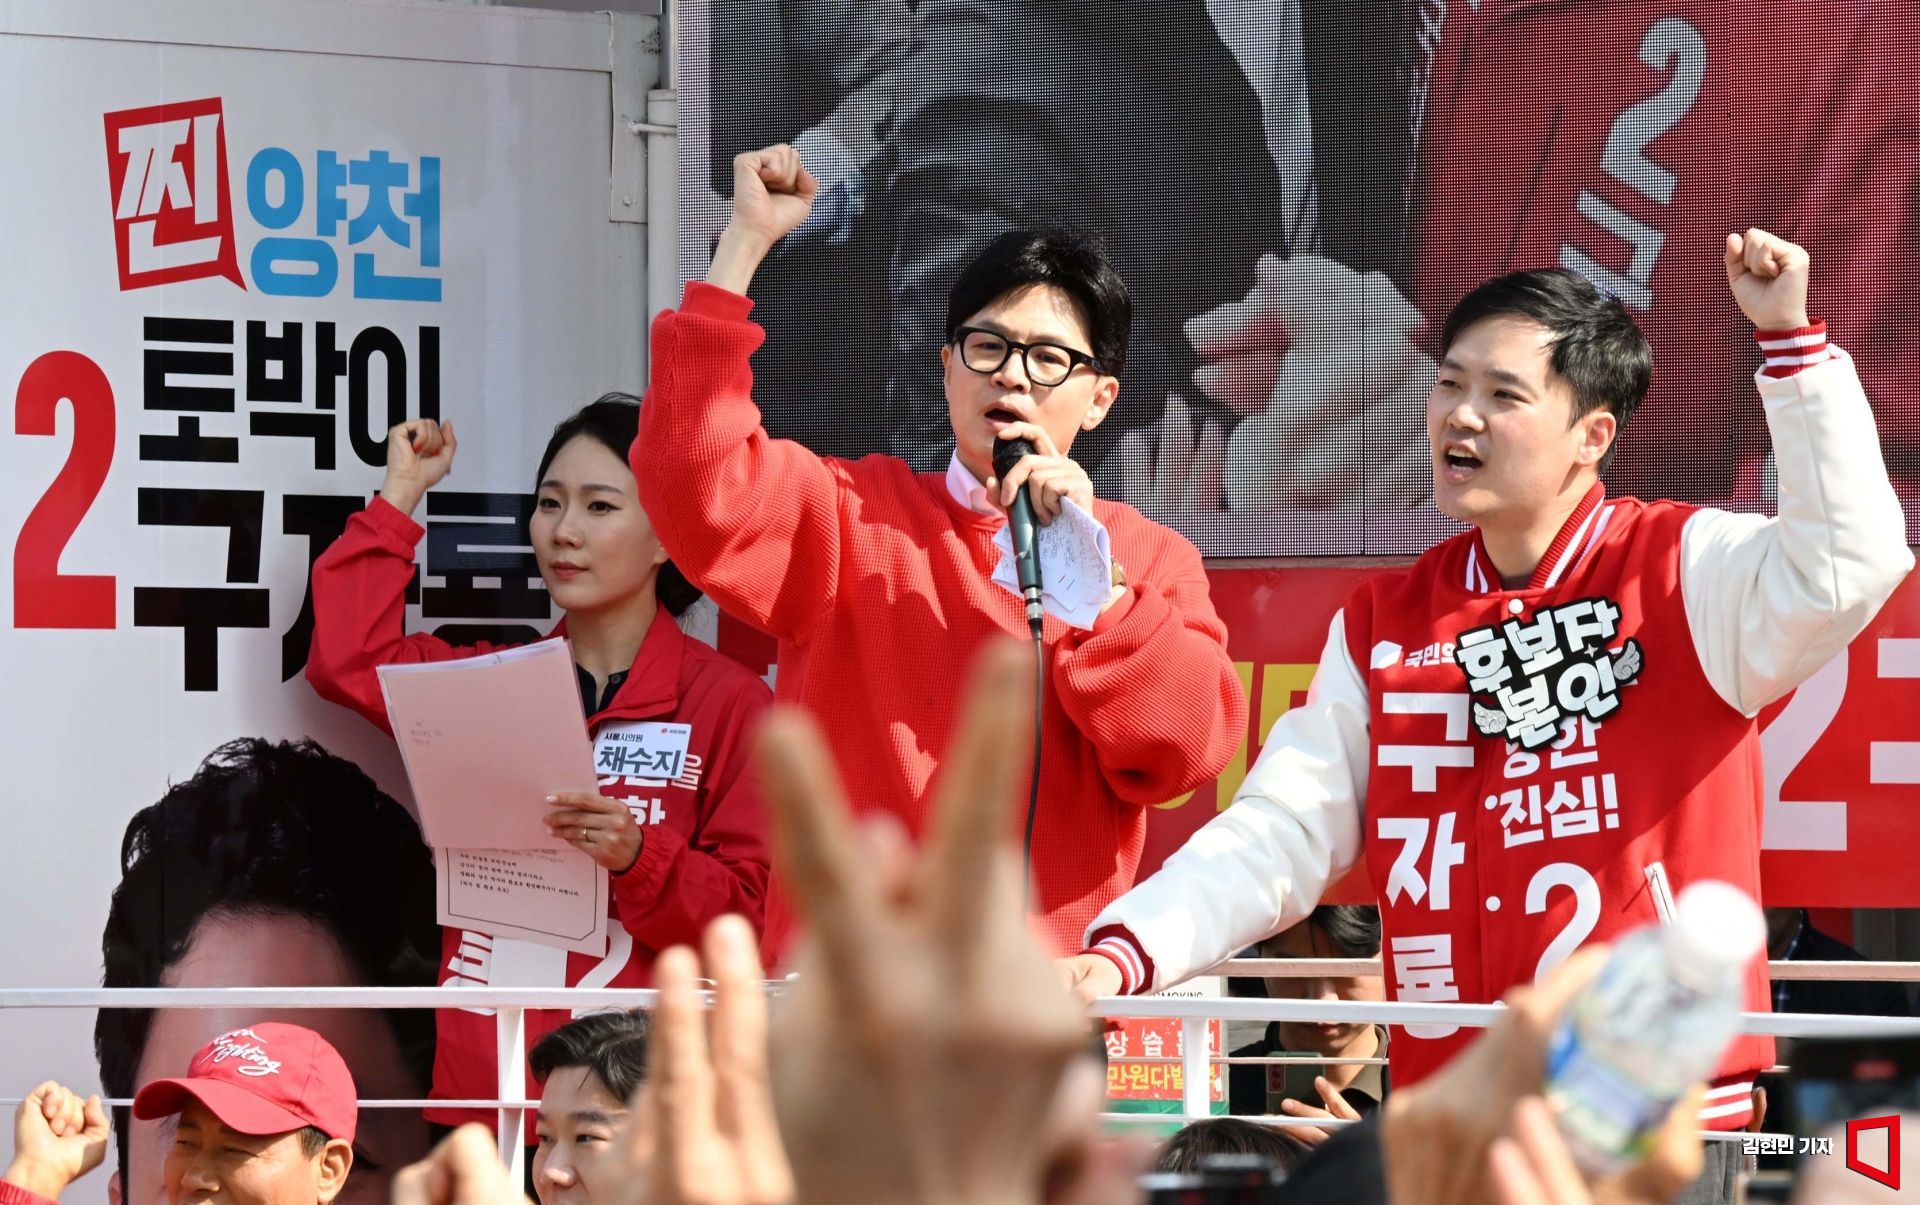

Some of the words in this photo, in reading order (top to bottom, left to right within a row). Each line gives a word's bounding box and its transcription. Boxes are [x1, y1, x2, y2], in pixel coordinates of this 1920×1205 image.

[116, 112, 221, 275] 찐
[247, 147, 443, 302] 양천
[139, 316, 441, 470] 토박이
[13, 350, 116, 629] 2
[1404, 641, 1457, 668] 국민의
[1457, 600, 1620, 693] 후보자
[1496, 655, 1620, 749] 본인
[597, 746, 682, 776] 채수지
[1500, 774, 1620, 849] 진심!
[1377, 692, 1475, 1039] 구자룡
[1525, 862, 1602, 988] 2
